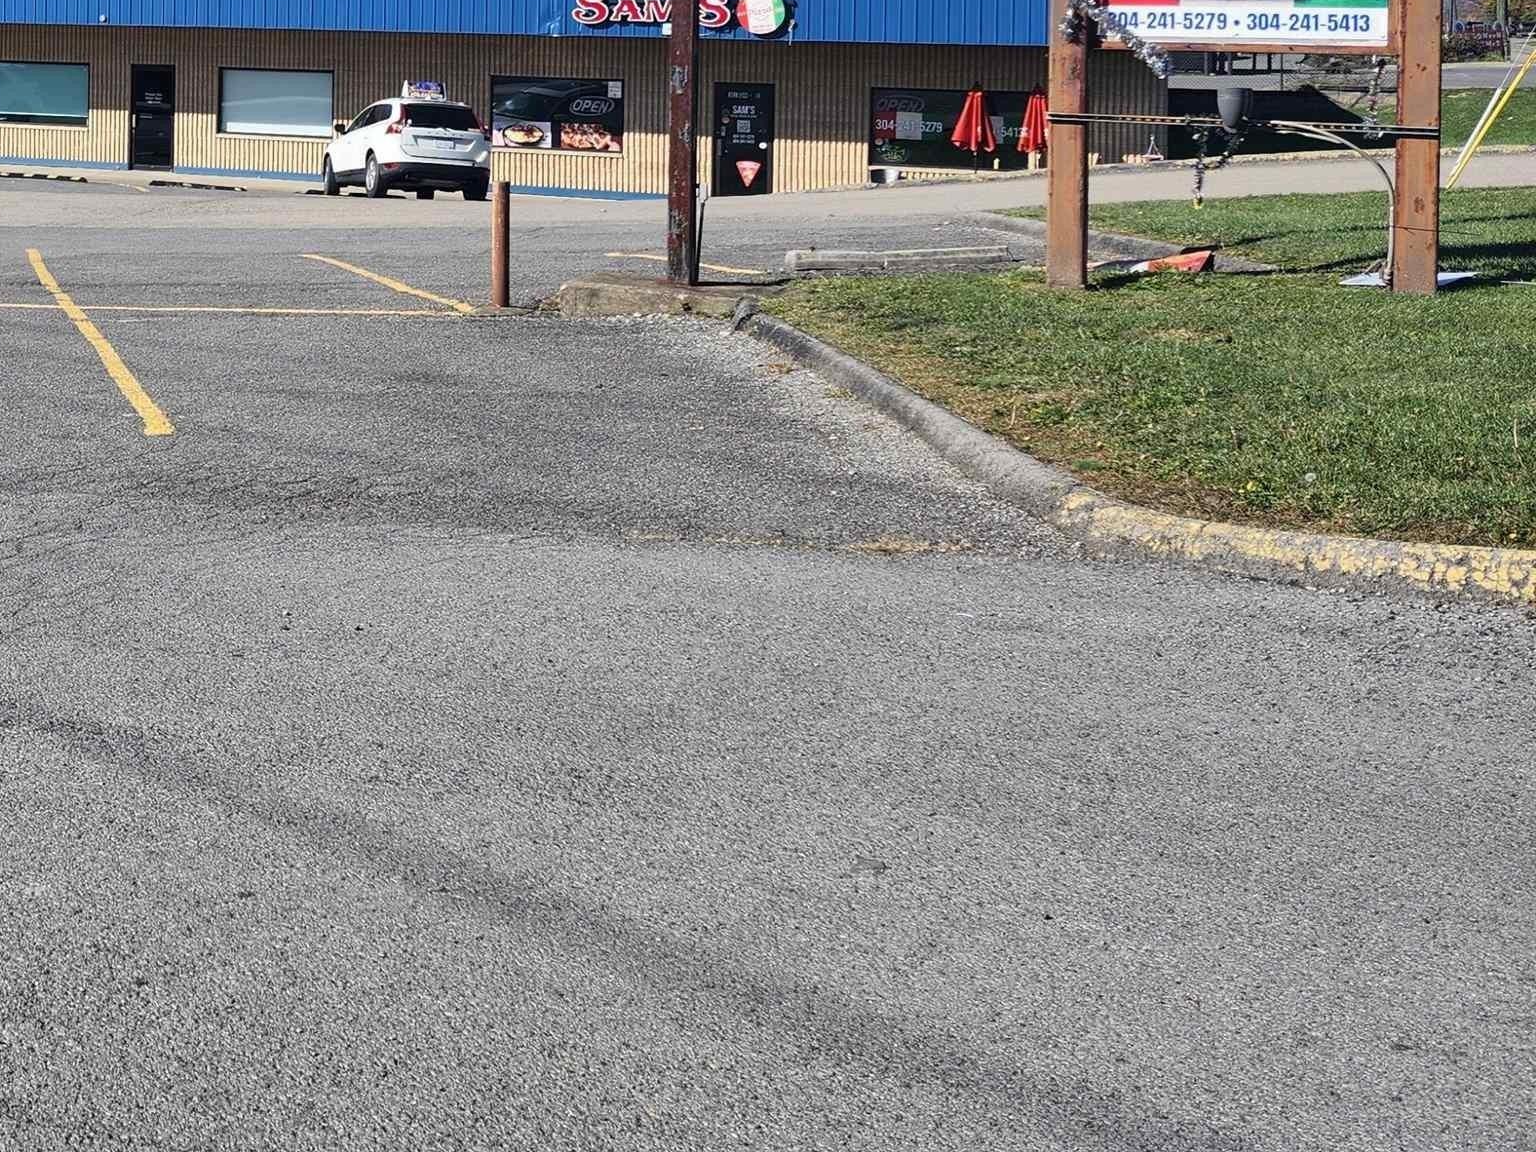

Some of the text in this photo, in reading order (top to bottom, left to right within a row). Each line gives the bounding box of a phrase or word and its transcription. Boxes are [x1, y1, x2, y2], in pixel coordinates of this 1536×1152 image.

[1107, 12, 1370, 31] 304-241-5279 304-241-5413
[573, 99, 609, 112] OPEN
